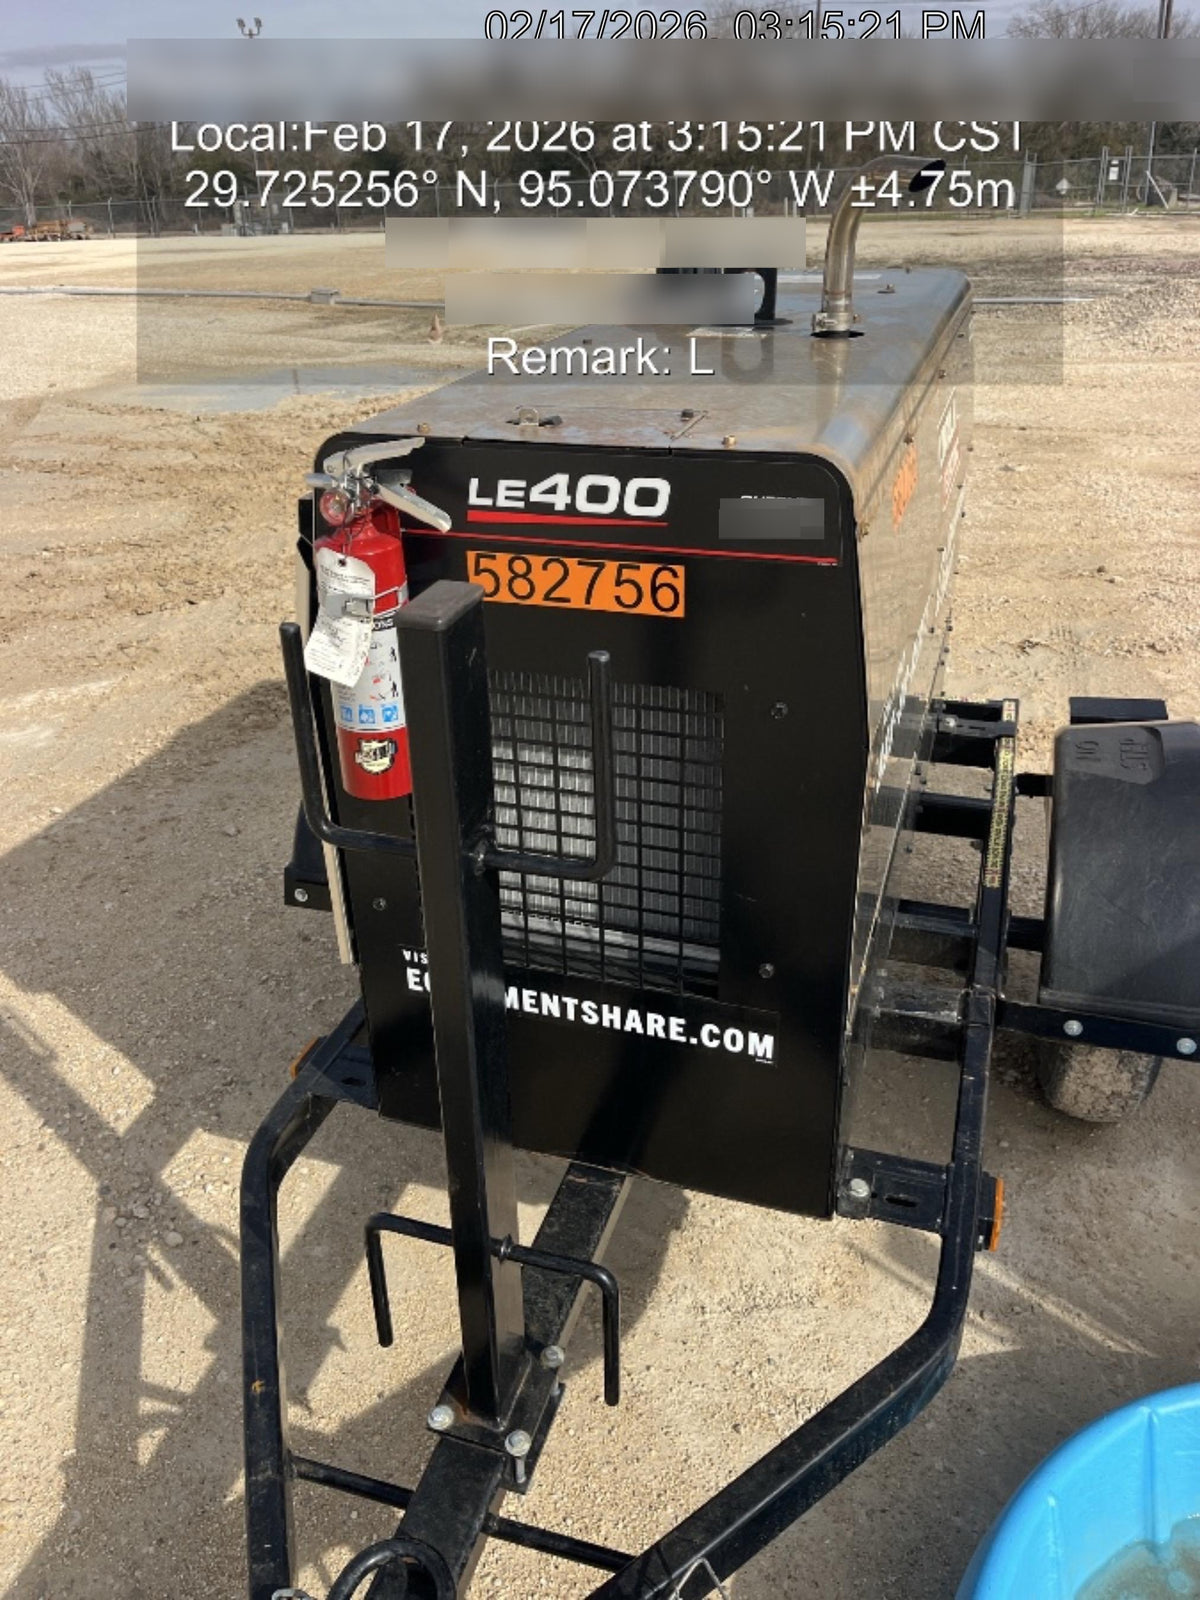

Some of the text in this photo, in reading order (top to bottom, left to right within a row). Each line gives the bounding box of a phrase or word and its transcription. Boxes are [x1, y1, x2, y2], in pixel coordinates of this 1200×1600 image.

[467, 472, 672, 518] LE400
[473, 551, 681, 613] 582756
[402, 948, 429, 965] VIS
[405, 967, 775, 1061] EMENTSHARE.COM
